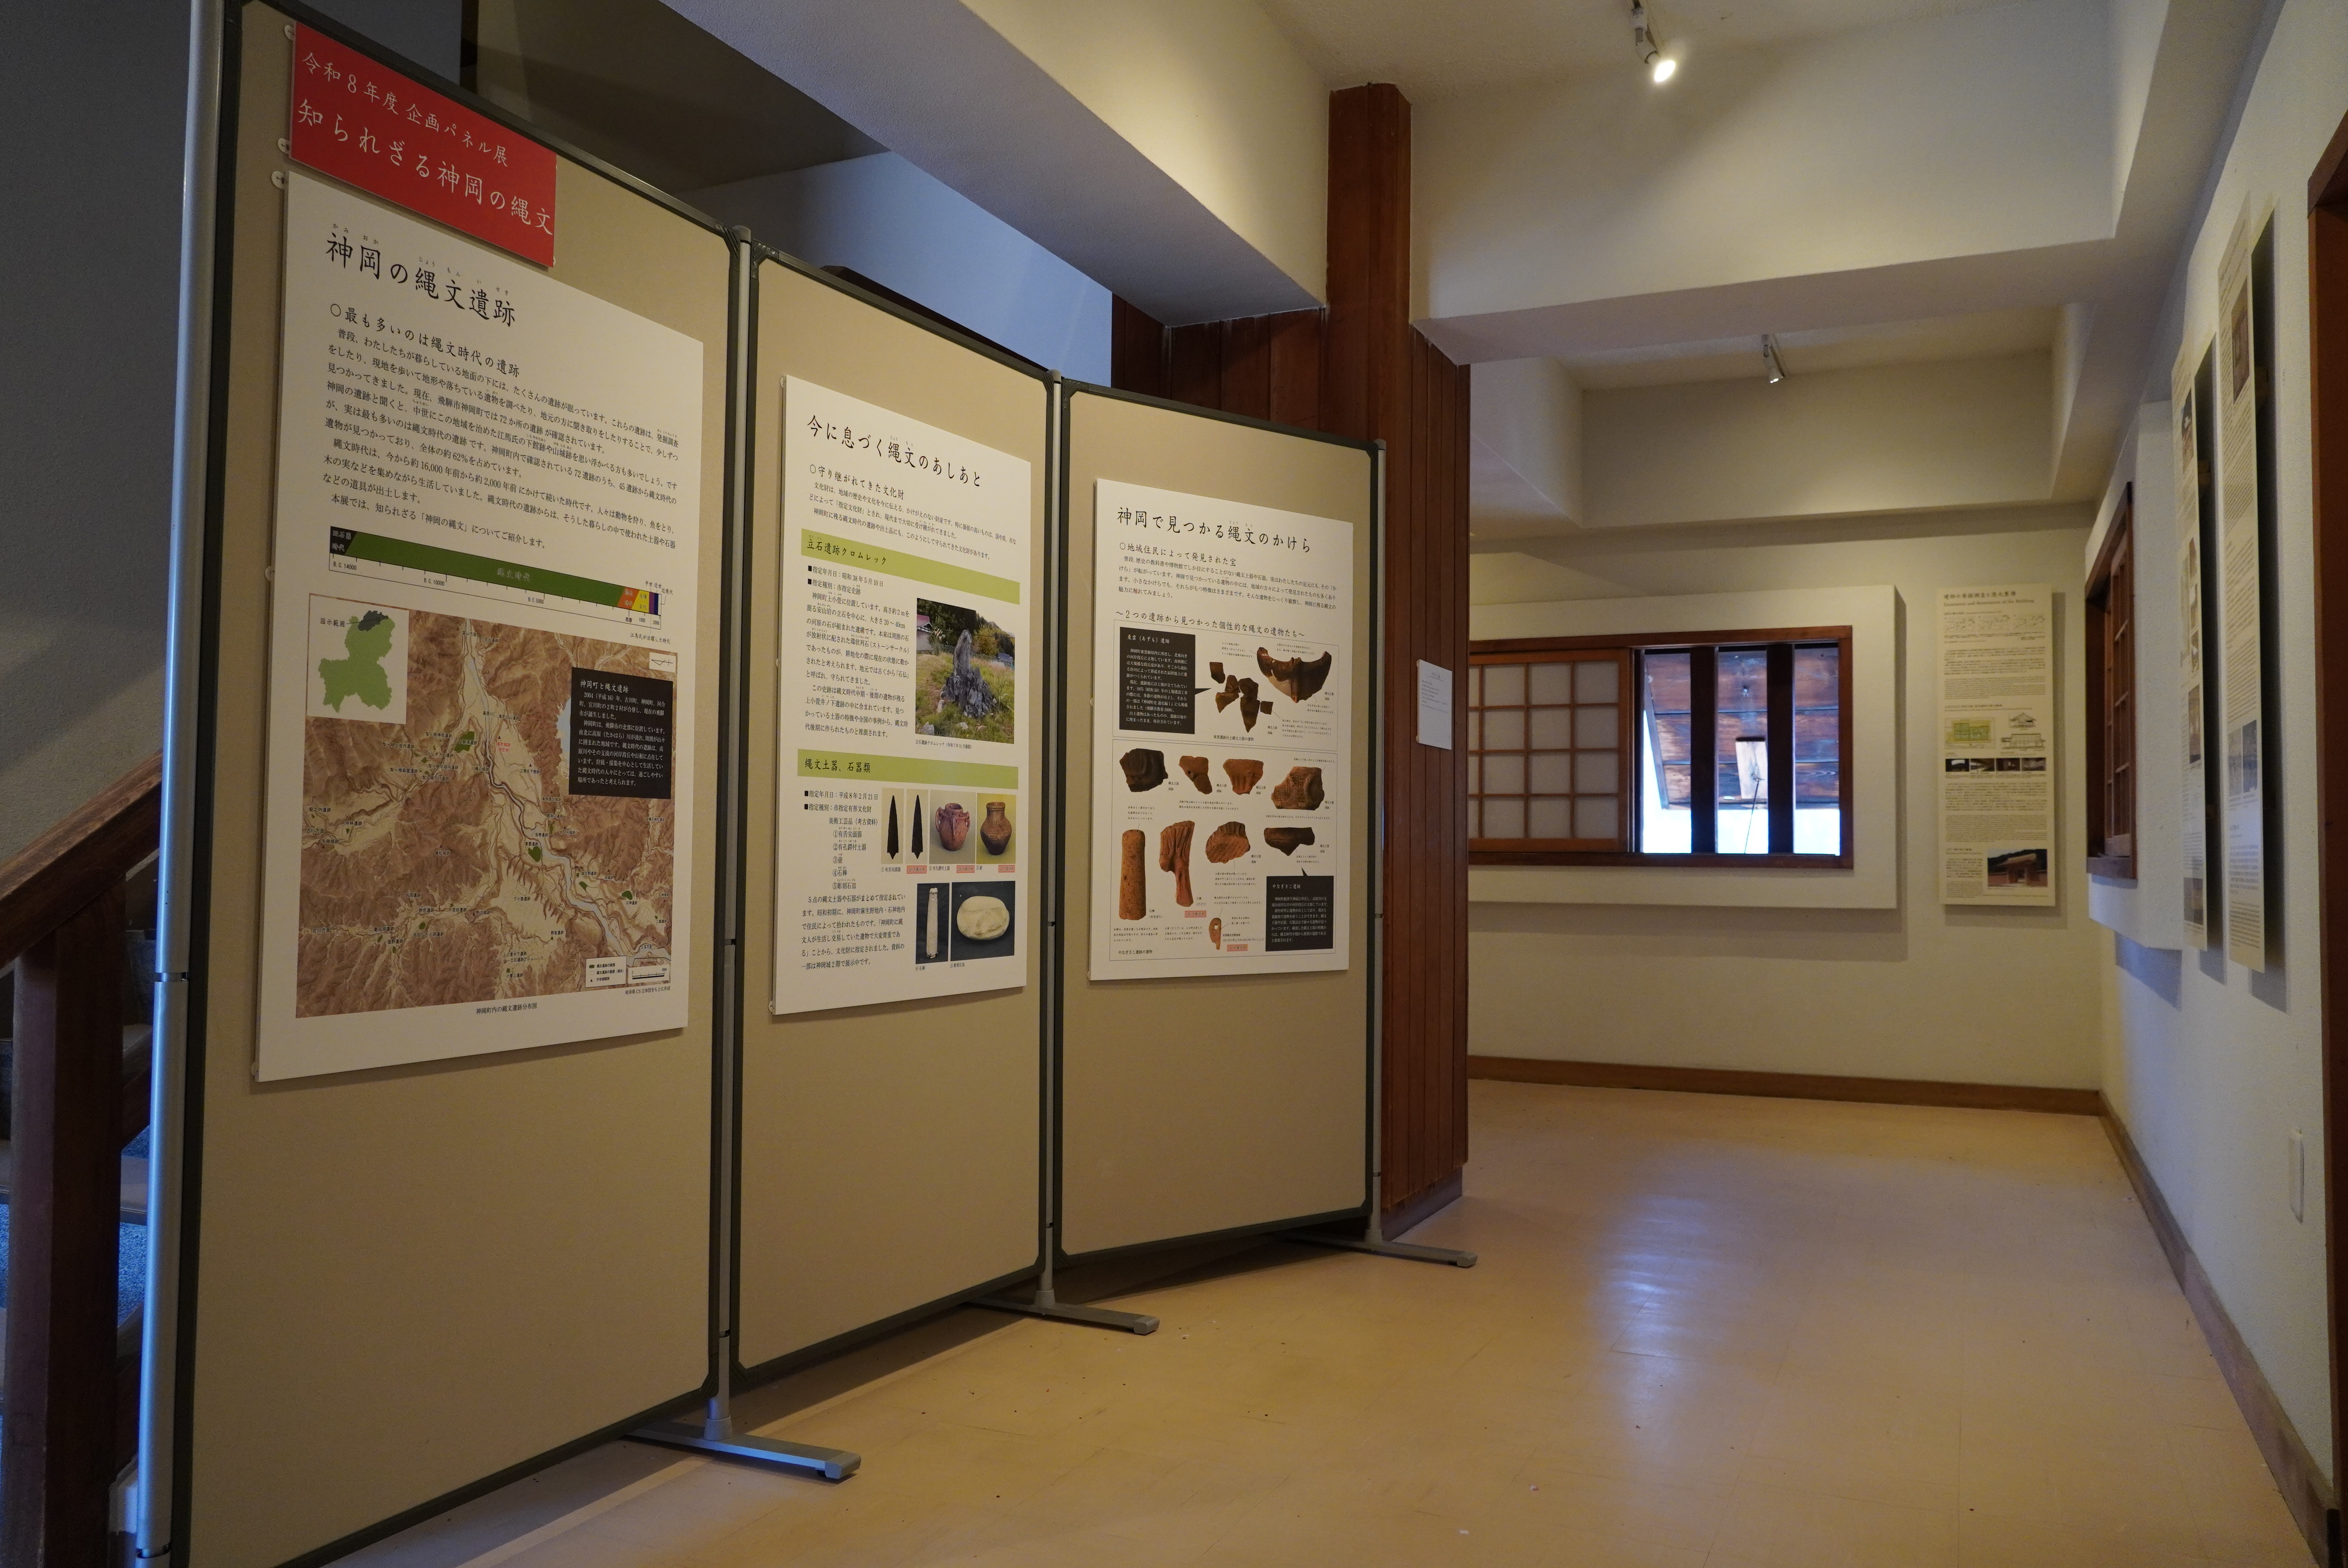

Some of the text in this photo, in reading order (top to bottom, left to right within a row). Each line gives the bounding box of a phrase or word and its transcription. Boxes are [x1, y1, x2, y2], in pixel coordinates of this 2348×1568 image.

[301, 47, 509, 169] 令和8年度企画パネル展
[296, 92, 554, 238] 知られざる神岡の縄文
[325, 229, 516, 331] 神岡の縄文遺跡
[322, 471, 421, 506] などの道具が出土します。
[806, 412, 980, 490] 今に息づく縄文のあしあと
[1116, 506, 1310, 555] 神岡で見つかる縄文のかけら
